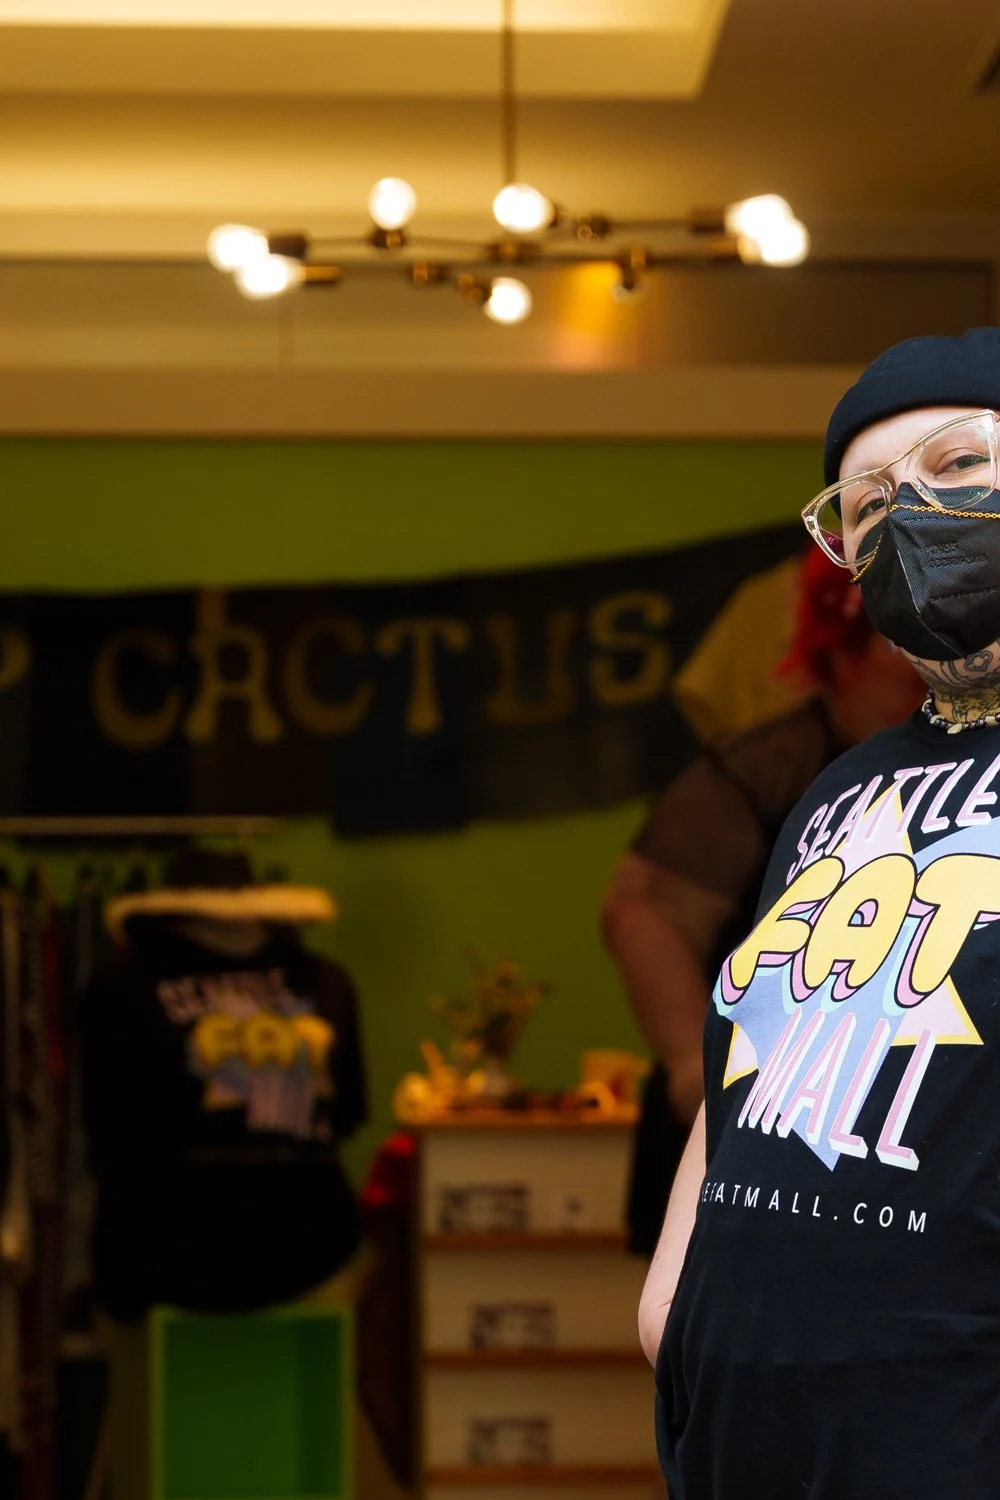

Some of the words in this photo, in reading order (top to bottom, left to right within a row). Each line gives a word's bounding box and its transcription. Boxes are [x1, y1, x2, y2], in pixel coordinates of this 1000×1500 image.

[90, 588, 673, 750] CACTUS
[737, 1006, 920, 1171] MALL
[702, 1181, 927, 1233] EFATMALL.COM
